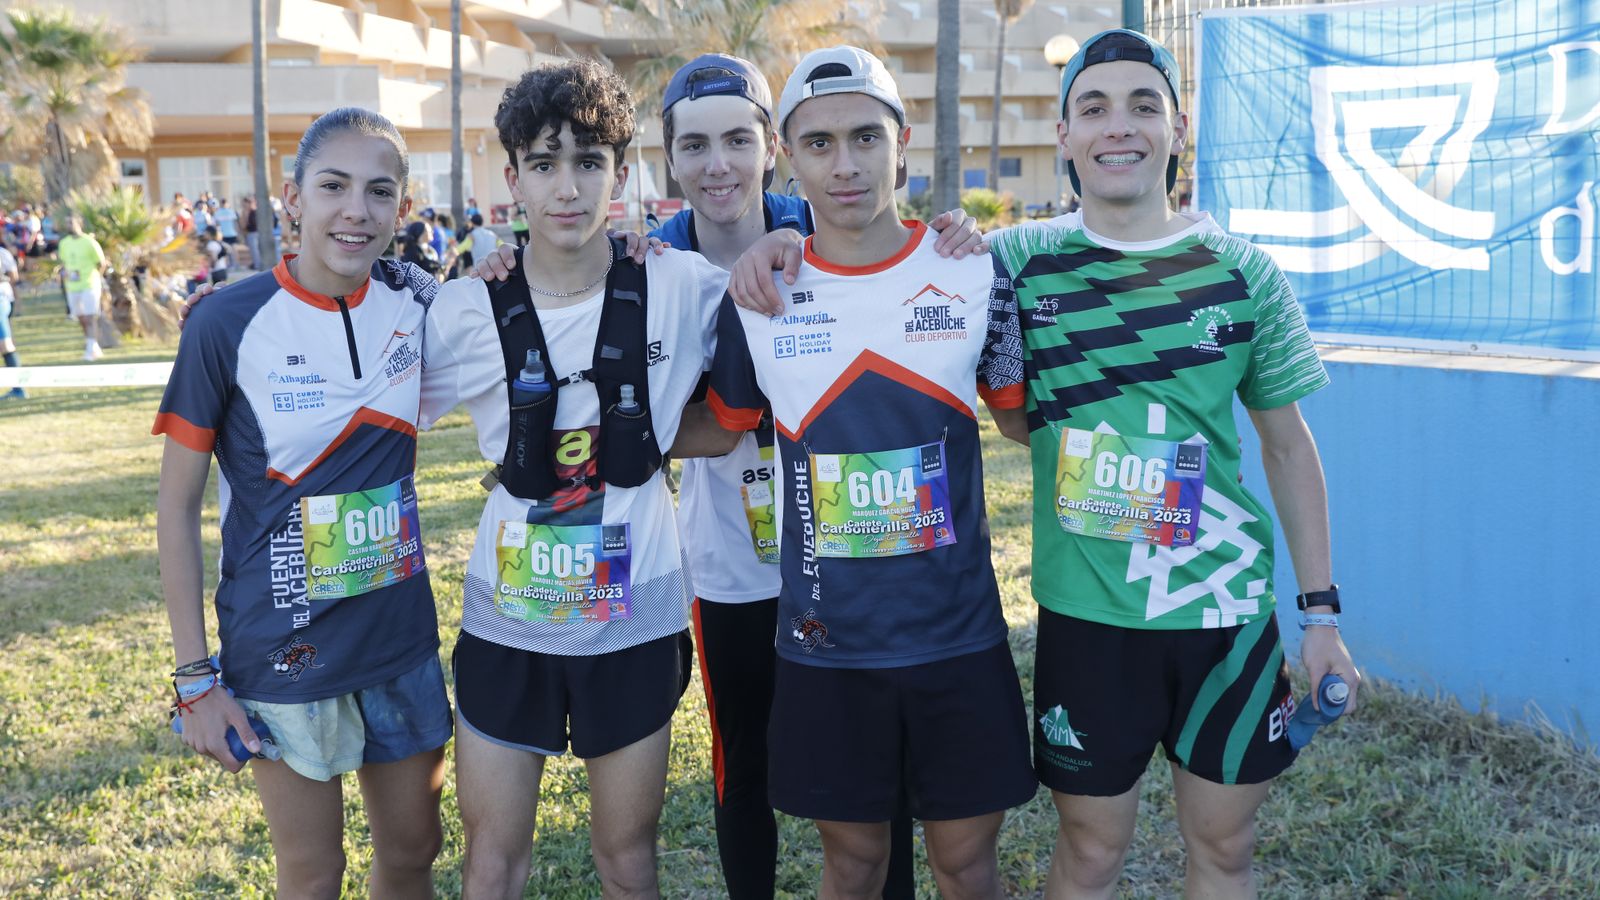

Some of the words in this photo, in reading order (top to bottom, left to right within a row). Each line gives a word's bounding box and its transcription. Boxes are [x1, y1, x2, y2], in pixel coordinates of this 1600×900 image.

[914, 305, 950, 319] FUENTE
[905, 320, 914, 333] DEL
[915, 317, 966, 332] ACEBUCHE
[799, 332, 832, 340] CUBO'S
[799, 340, 831, 348] HOLIDAY
[905, 333, 926, 343] CLUB
[927, 331, 967, 342] DEPORTIVO
[388, 342, 410, 365] FUENTE
[800, 347, 833, 355] HOMES
[296, 390, 324, 398] CUBO'S
[297, 402, 326, 410] HOMES
[1094, 450, 1168, 495] 606
[848, 467, 917, 508] 604
[1058, 495, 1149, 520] Carbonerilla
[1153, 509, 1191, 525] 2023
[1087, 497, 1122, 510] Cadete
[344, 500, 400, 546] 600
[820, 520, 910, 535] Carbonerilla
[914, 511, 945, 528] 2023
[848, 519, 882, 528] Cadete
[311, 553, 395, 577] Carbonerilla
[398, 541, 418, 560] 2023
[343, 555, 375, 568] Cadete
[530, 540, 595, 578] 605
[270, 531, 293, 609] FUENTE
[500, 583, 584, 602] Carbonerilla
[588, 588, 624, 600] 2023
[527, 584, 558, 595] Cadete
[812, 582, 821, 601] DEL
[293, 609, 310, 629] DEL
